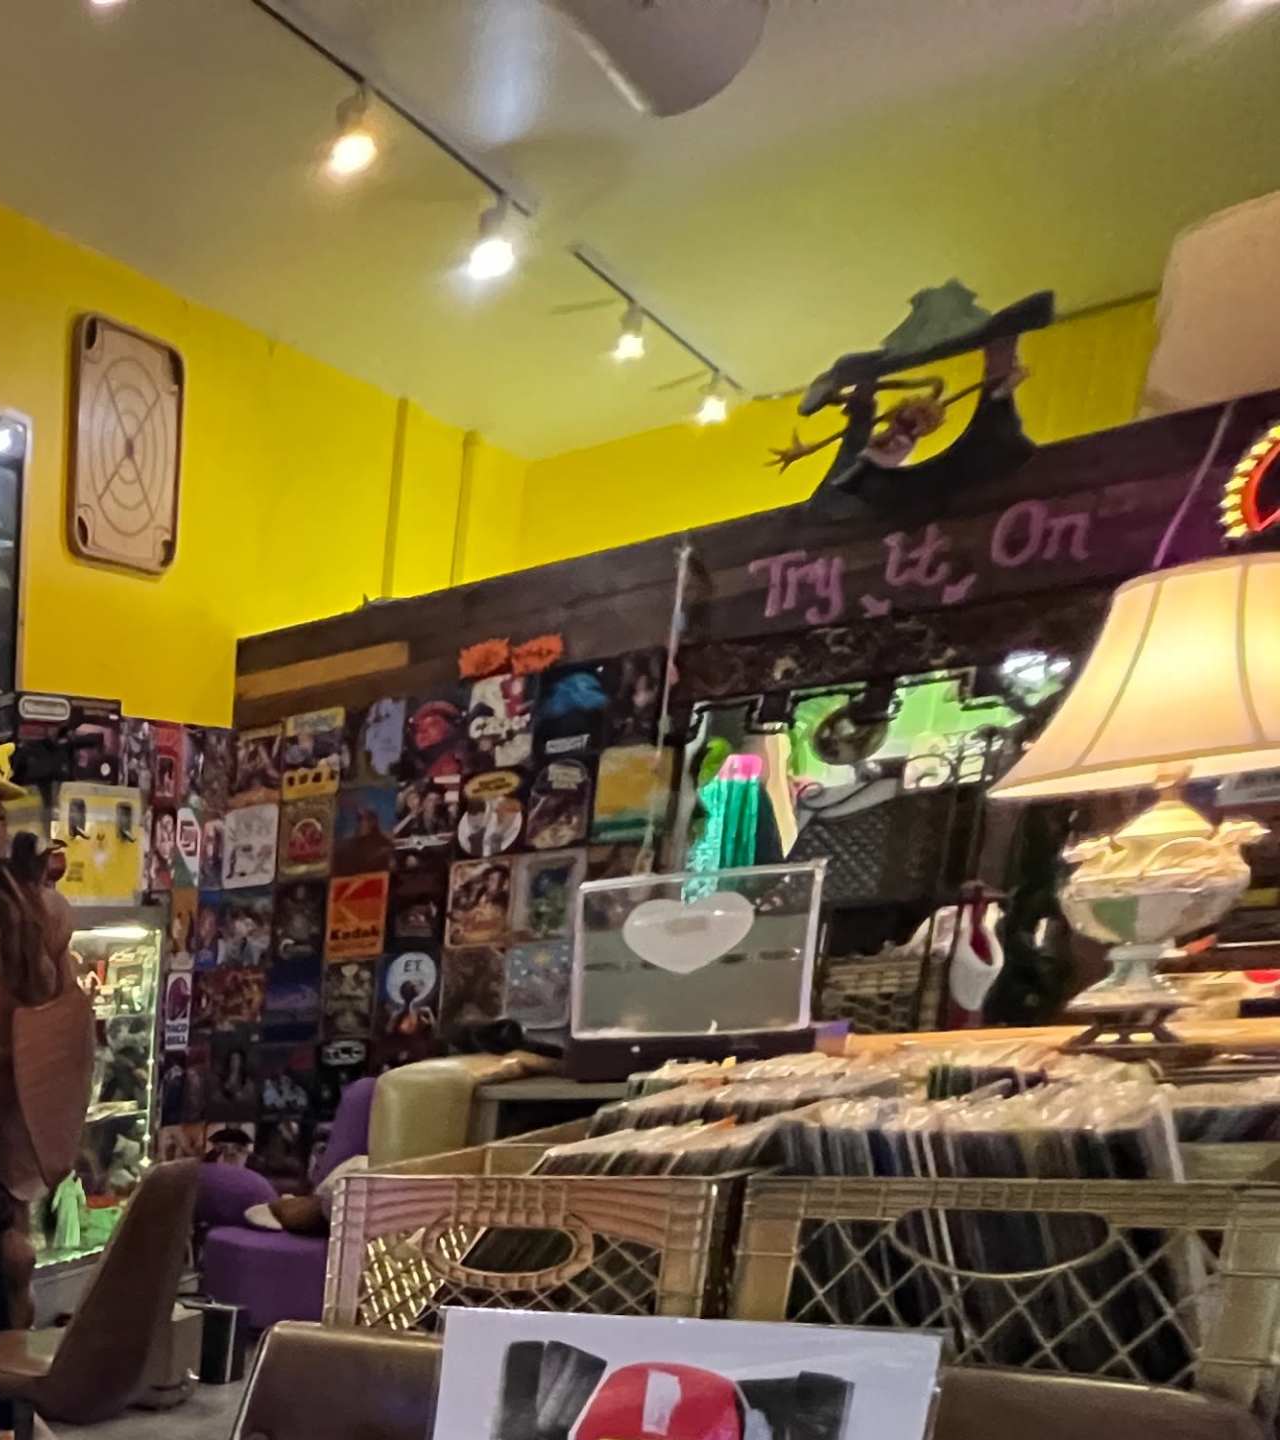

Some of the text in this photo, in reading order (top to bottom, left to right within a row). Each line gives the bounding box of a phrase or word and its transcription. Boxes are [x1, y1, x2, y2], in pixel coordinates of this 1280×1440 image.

[748, 550, 846, 626] Try
[990, 500, 1090, 568] On
[329, 926, 381, 942] Kodak
